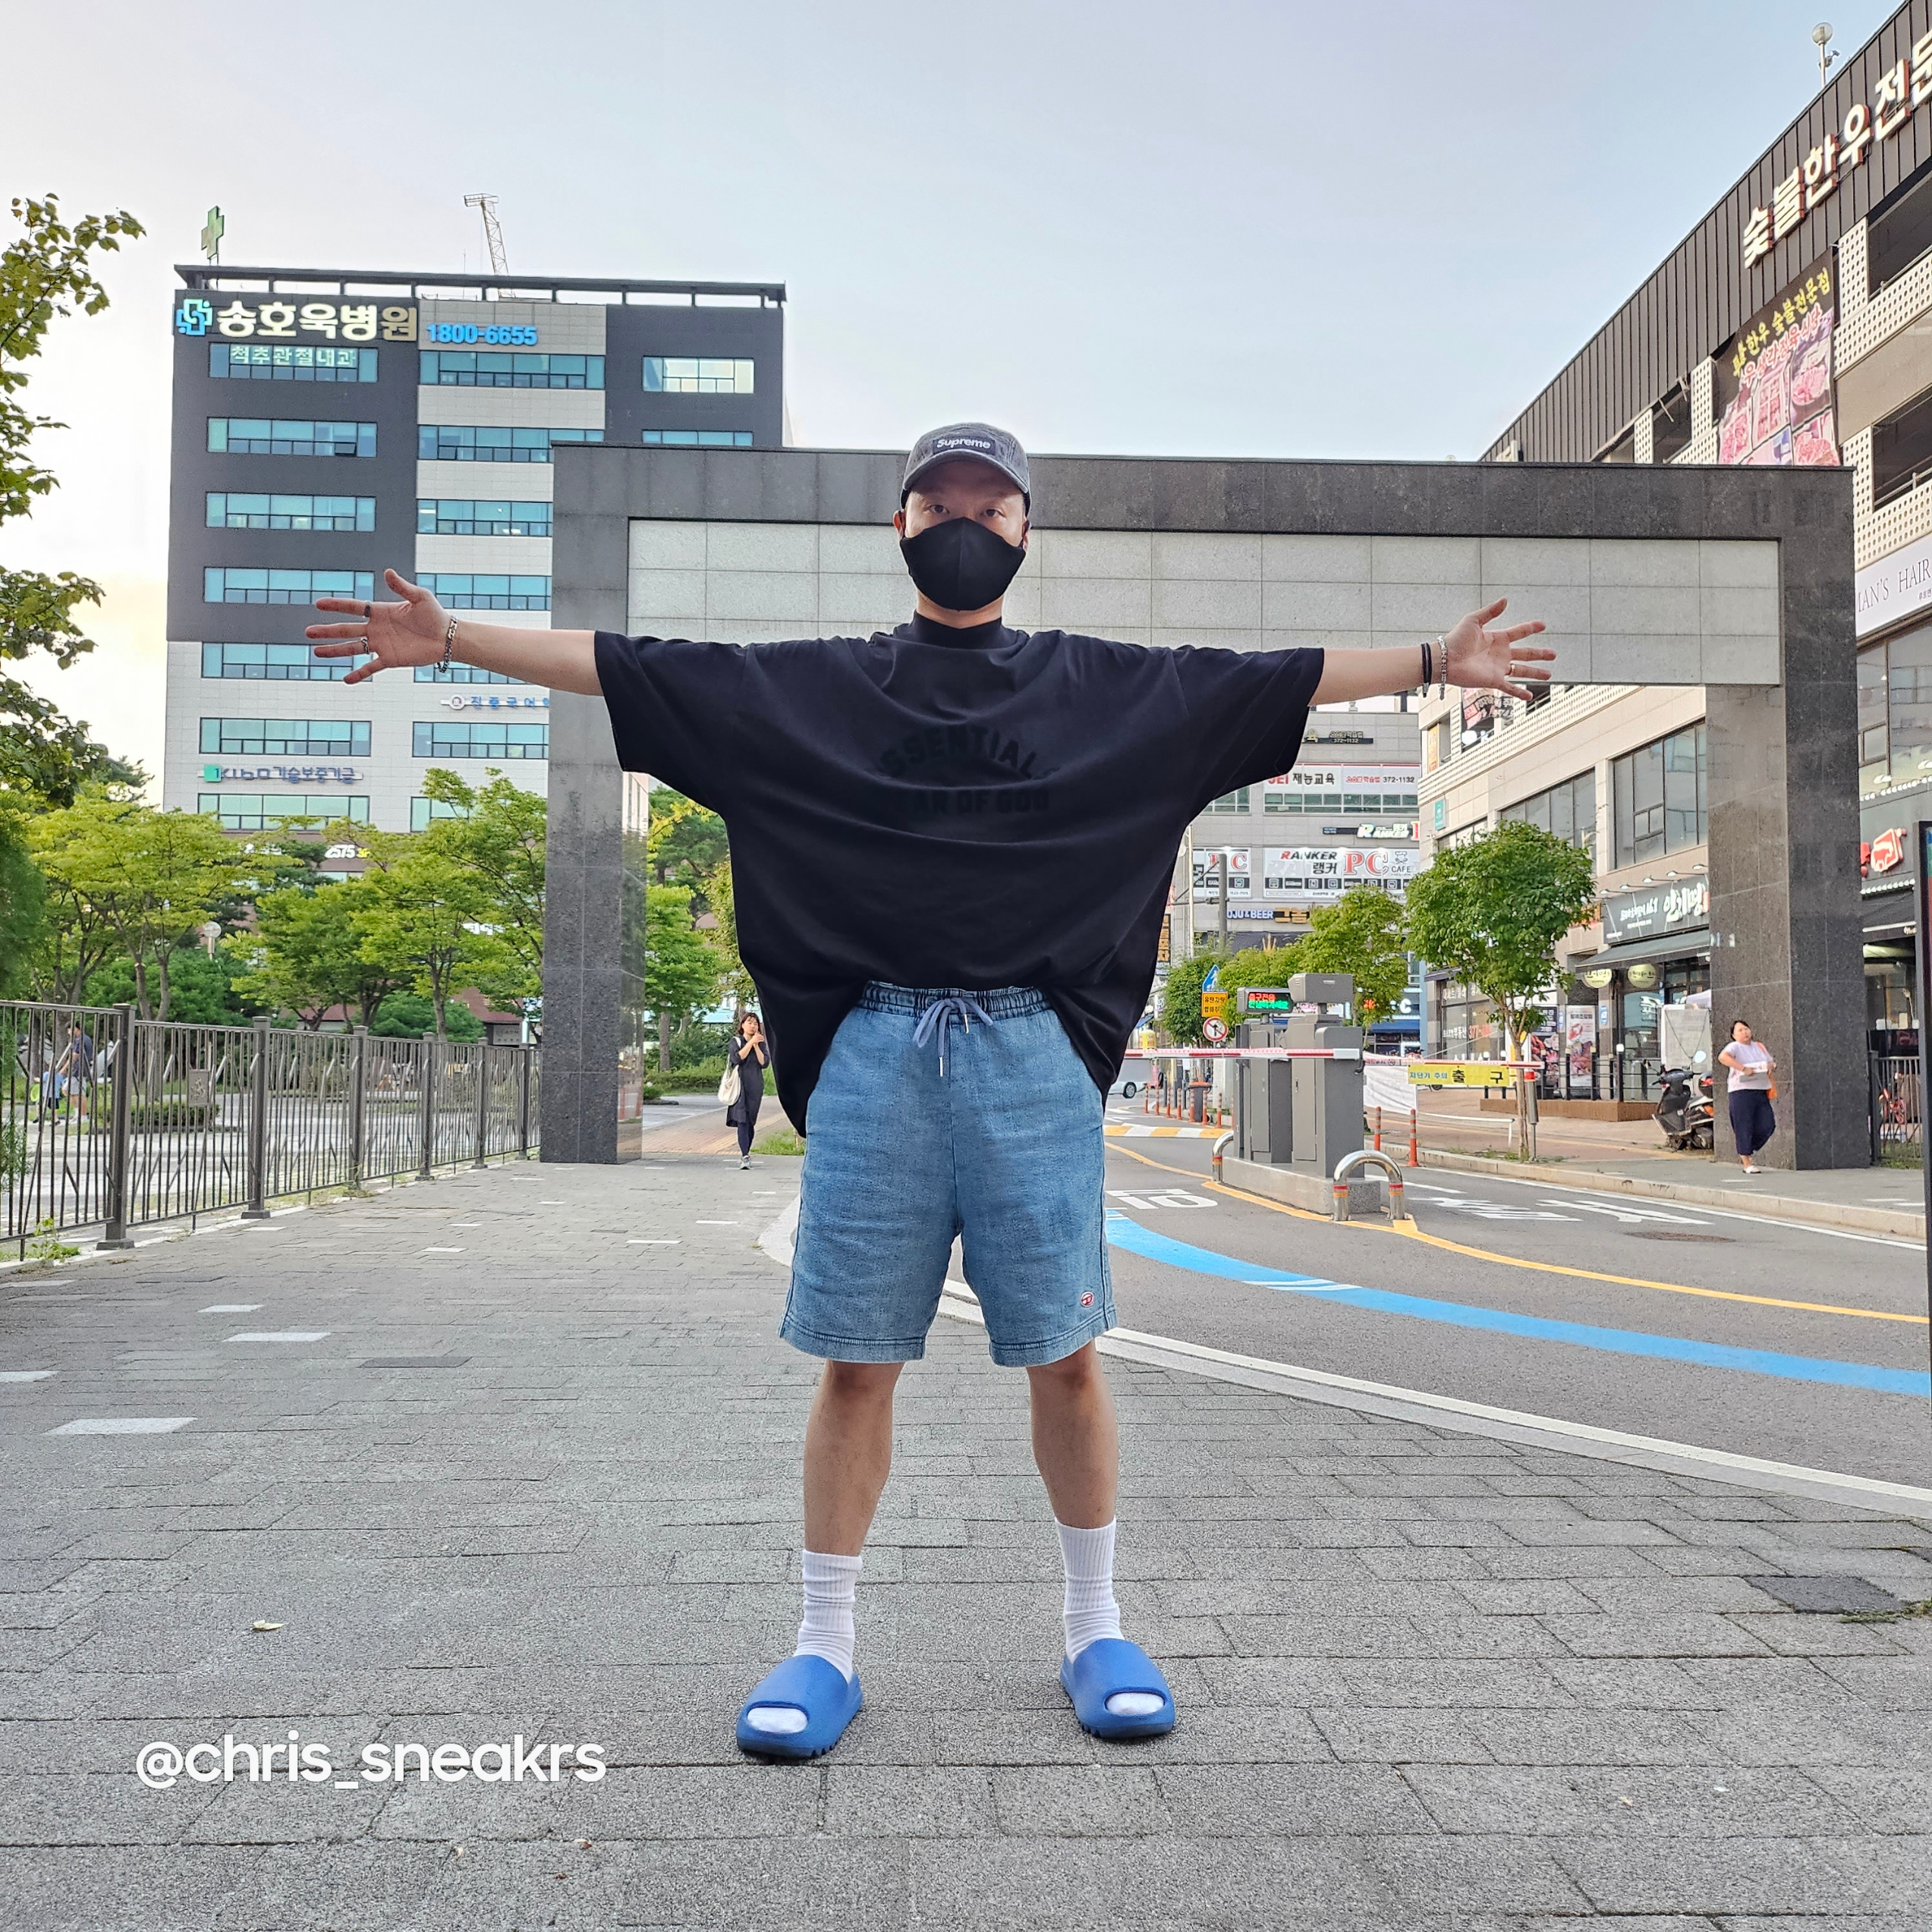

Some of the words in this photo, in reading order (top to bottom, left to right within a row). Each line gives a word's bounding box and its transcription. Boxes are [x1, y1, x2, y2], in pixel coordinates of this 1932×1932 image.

[218, 301, 417, 341] 송호욱병원
[427, 324, 538, 345] 1800-6655
[230, 345, 356, 367] 척추관절내과
[936, 439, 991, 448] Supreme
[1898, 558, 1931, 593] HAIR
[879, 724, 1060, 779] SSENTIAL
[273, 766, 354, 785] 기술보증기금
[1292, 772, 1336, 785] 재능교육
[1280, 851, 1338, 860] RANKER
[1342, 851, 1389, 876] PC
[1312, 861, 1338, 875] 랭커
[1433, 1071, 1448, 1079] 주의
